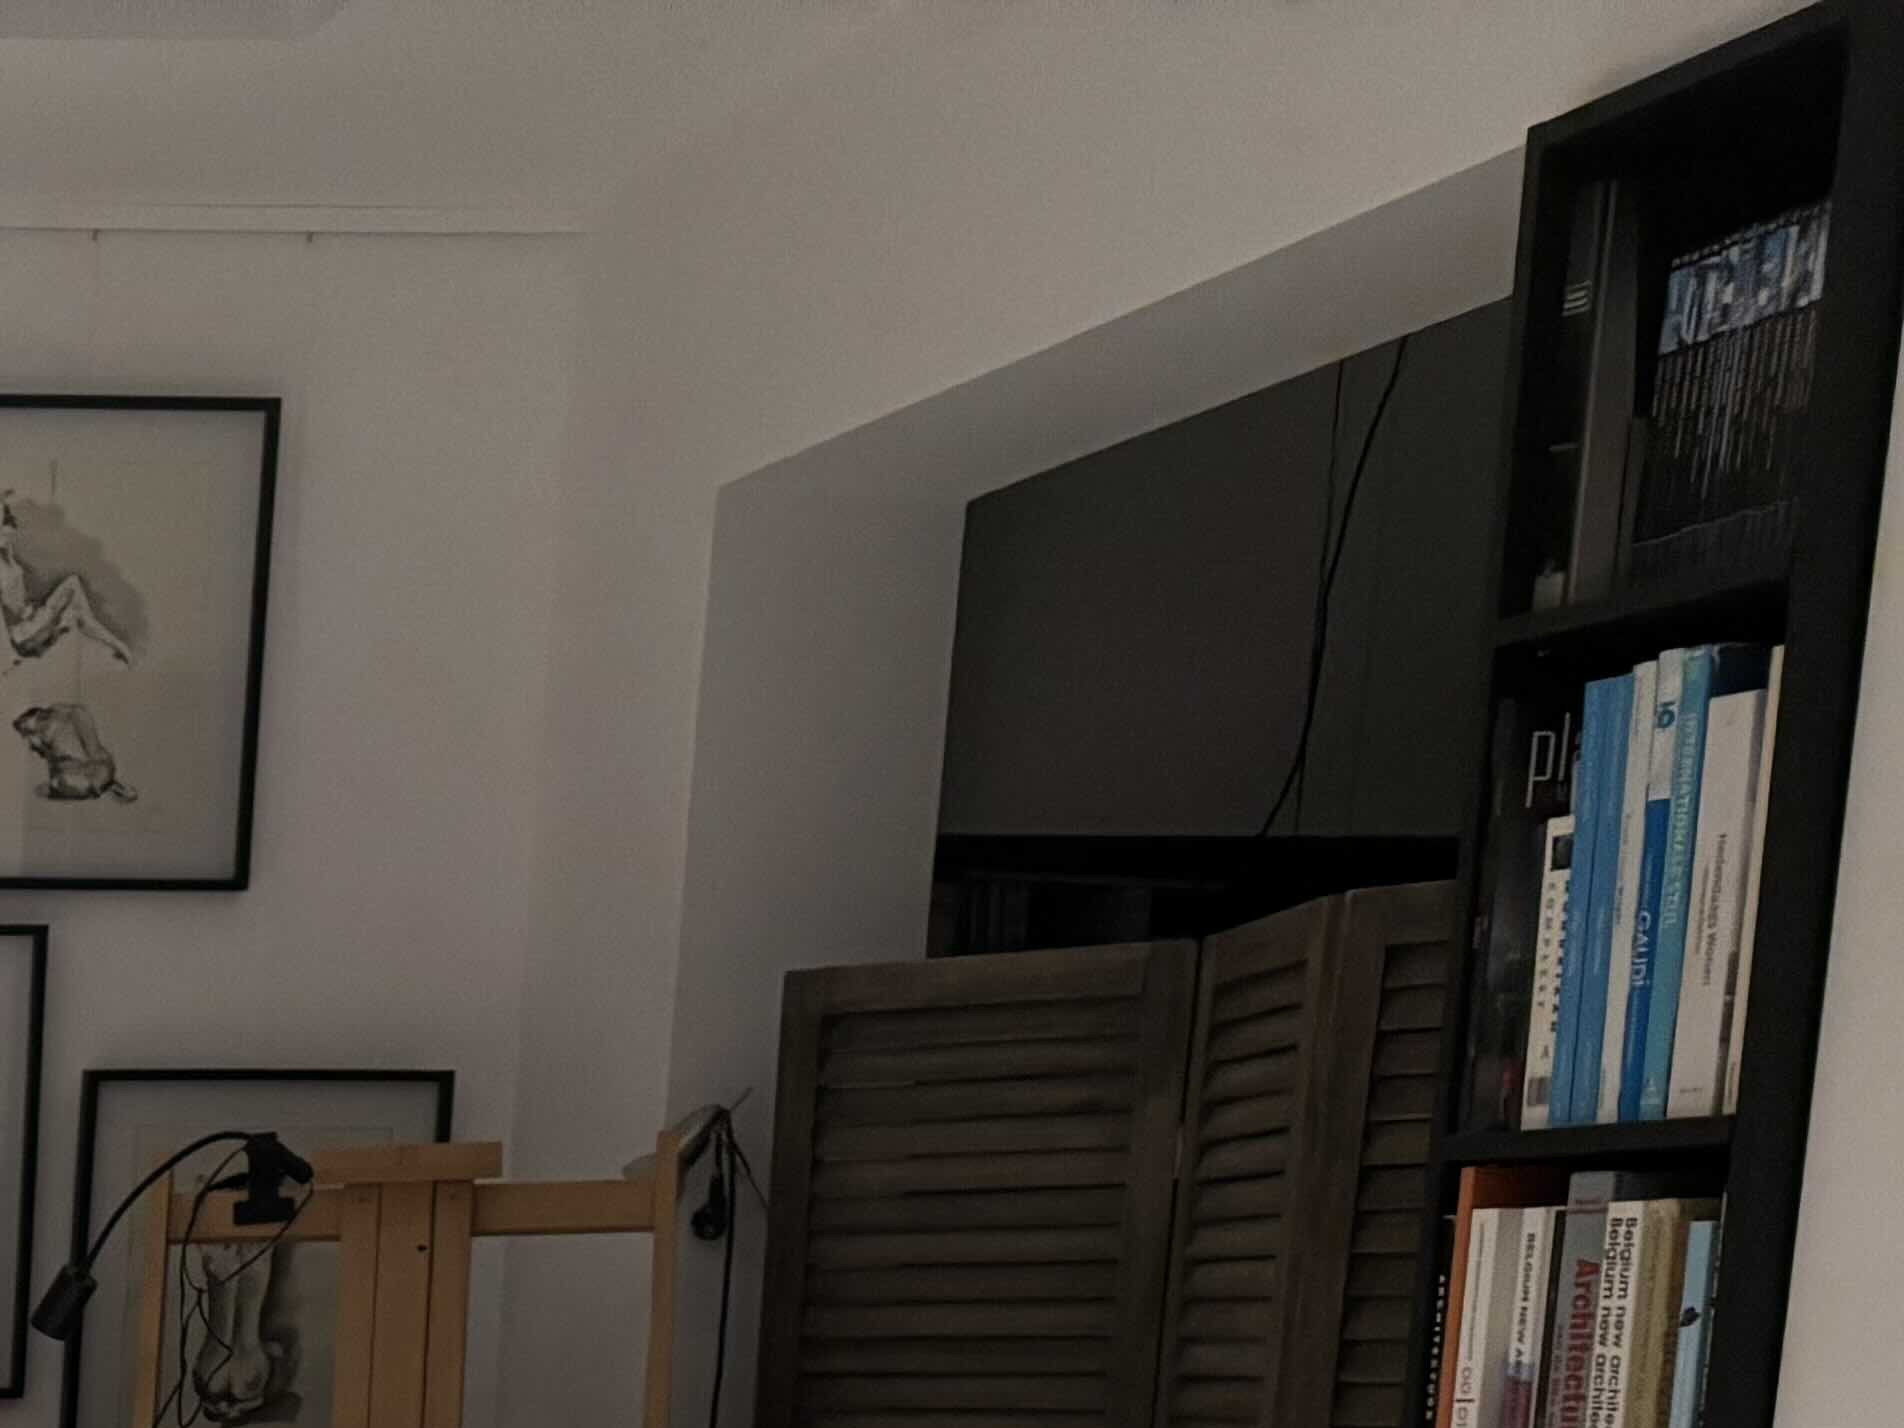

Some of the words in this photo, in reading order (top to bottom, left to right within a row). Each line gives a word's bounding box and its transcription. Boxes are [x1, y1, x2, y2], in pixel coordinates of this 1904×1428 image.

[1520, 1232, 1537, 1303] BELGIUM
[1600, 1216, 1623, 1300] Belgium
[1615, 1216, 1639, 1300] Belgium
[1516, 1306, 1529, 1345] NEW
[1598, 1305, 1612, 1349] new
[1612, 1305, 1627, 1349] new
